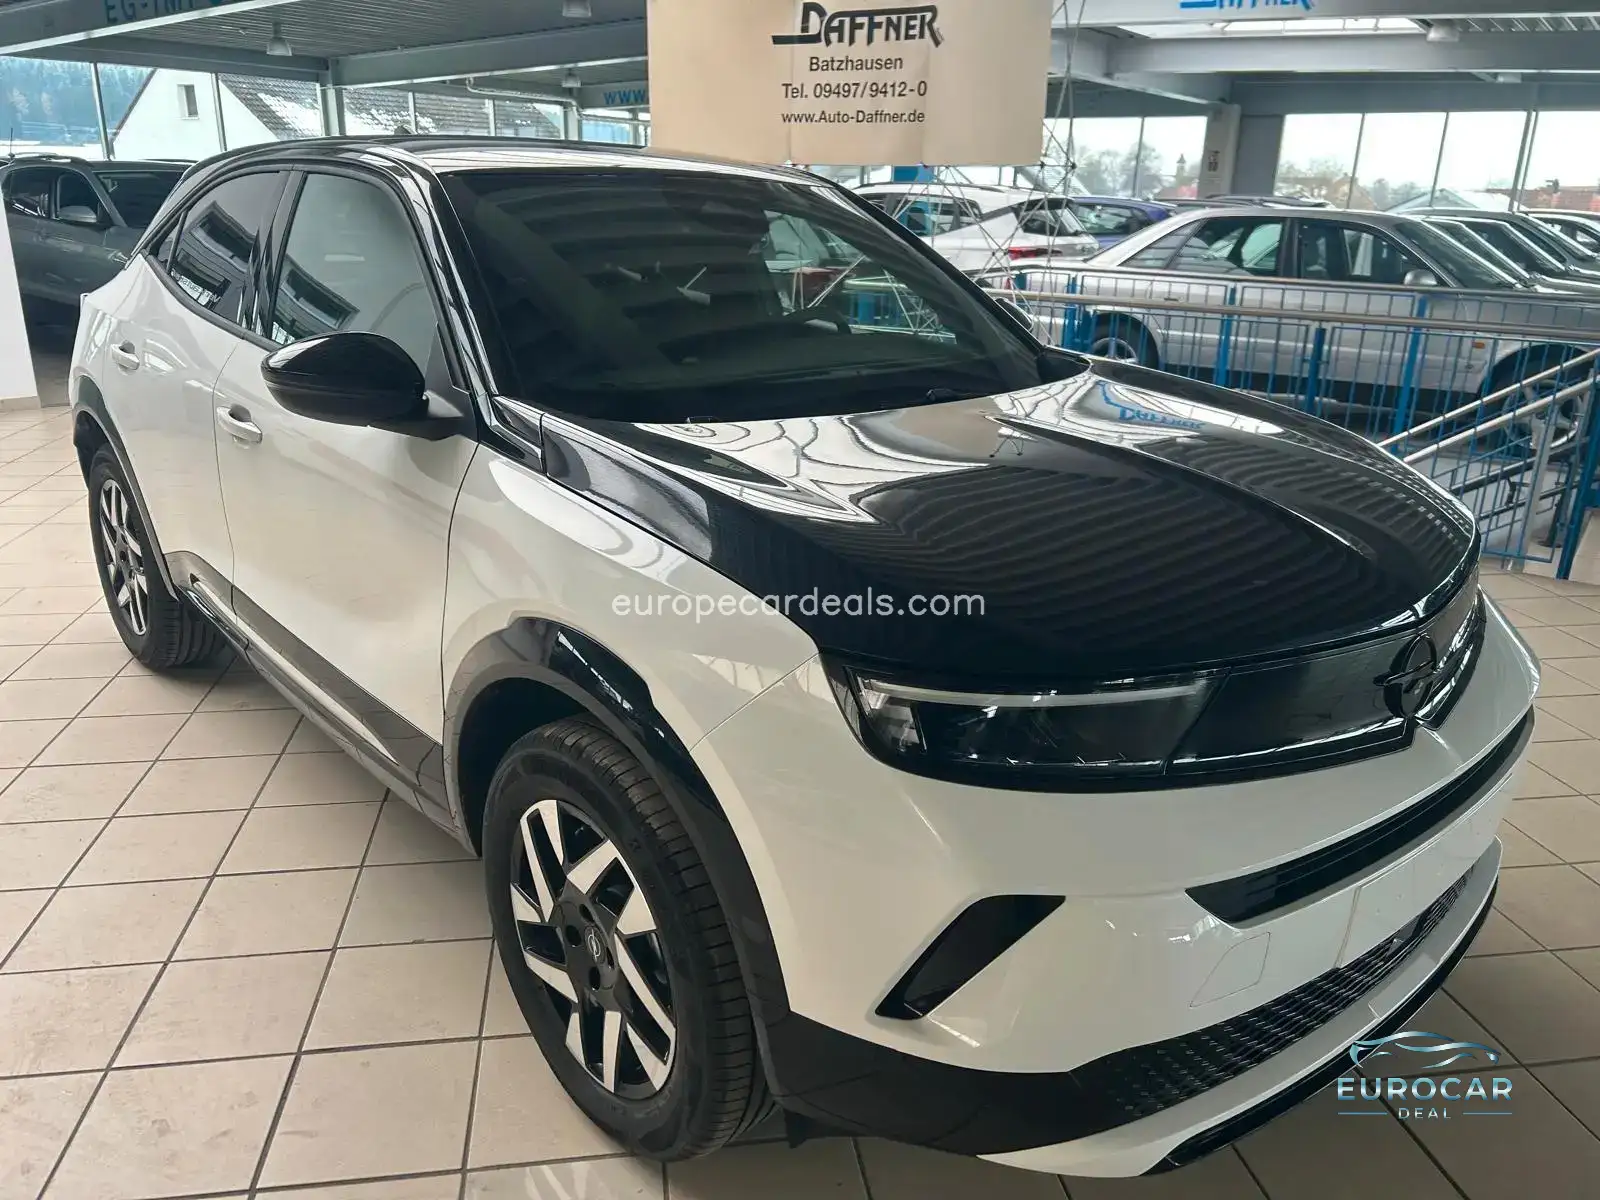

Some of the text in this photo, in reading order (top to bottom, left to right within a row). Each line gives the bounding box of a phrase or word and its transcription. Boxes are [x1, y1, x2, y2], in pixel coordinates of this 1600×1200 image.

[809, 56, 903, 72] Batzhausen
[781, 81, 927, 99] Tel. 09497/9412-0
[781, 109, 925, 125] www.Auto-Daffner.de
